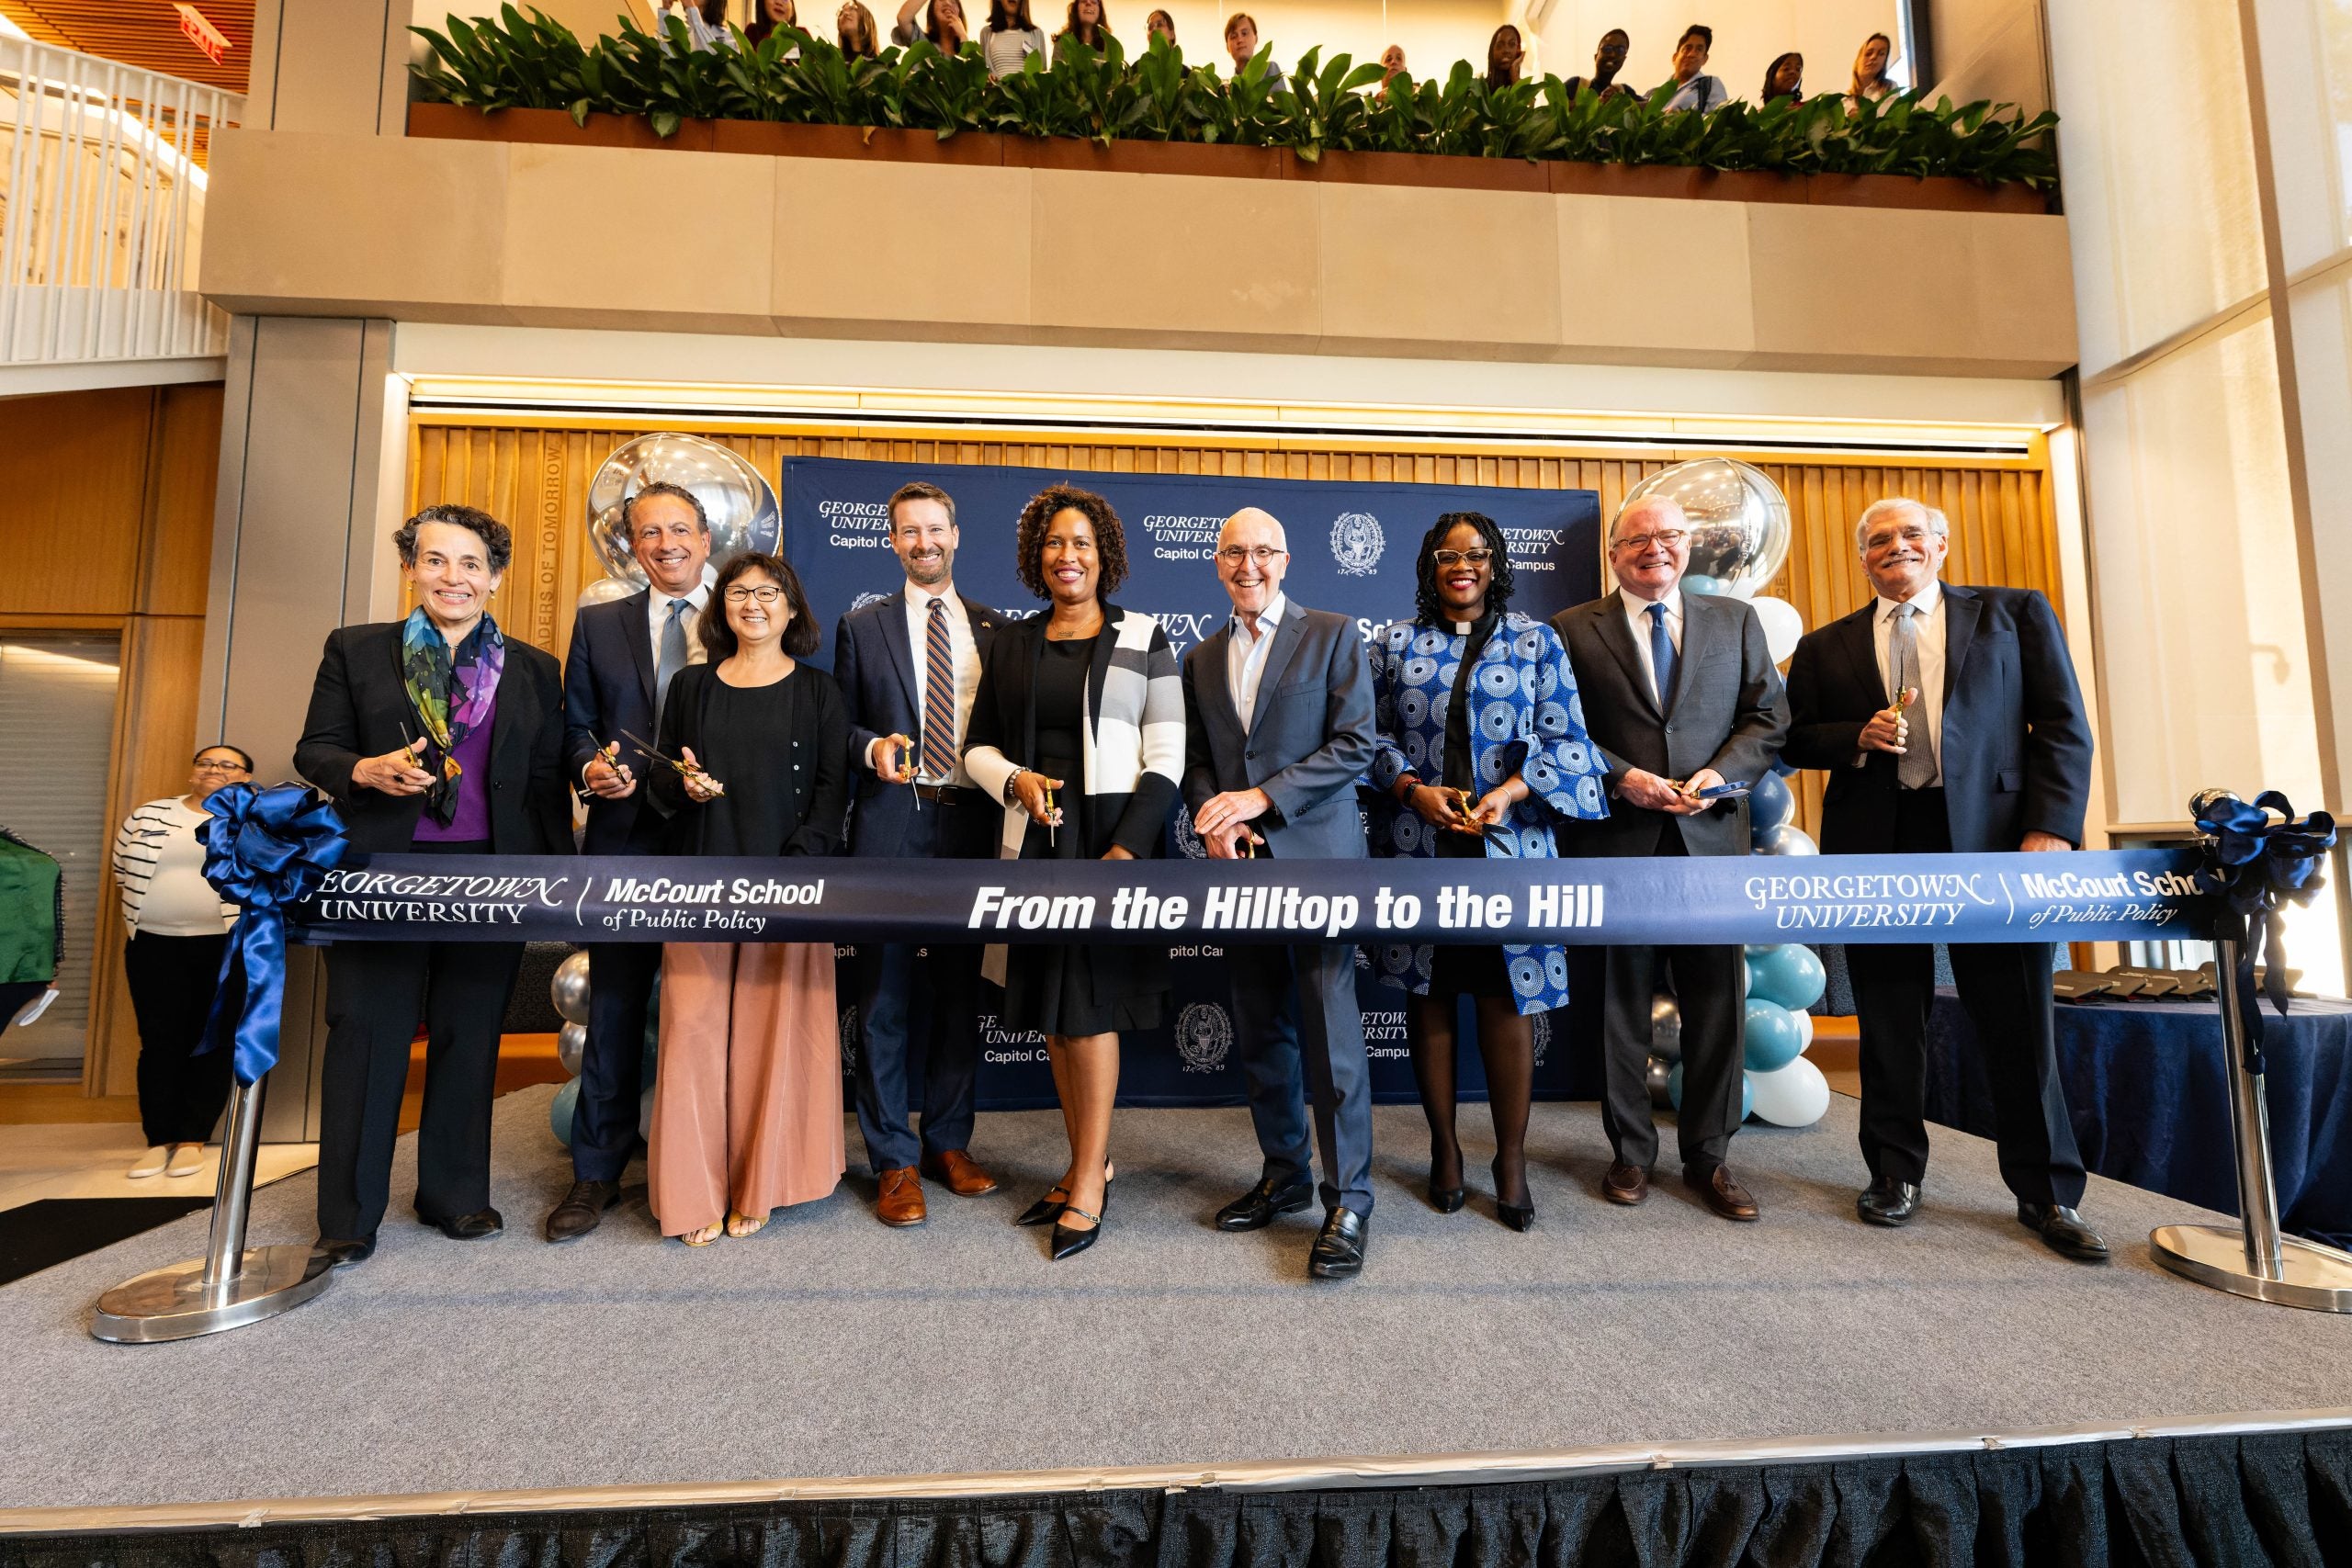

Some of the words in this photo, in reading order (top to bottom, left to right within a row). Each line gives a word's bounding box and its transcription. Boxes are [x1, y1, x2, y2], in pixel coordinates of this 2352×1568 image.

[819, 501, 888, 518] GEORGE
[831, 515, 891, 531] UNIVER
[1143, 514, 1228, 532] GEORGETO
[830, 535, 877, 549] Capitol
[1155, 529, 1220, 543] UNIVERS
[1498, 527, 1565, 546] ETOWN
[1154, 547, 1199, 561] Capitol
[1505, 541, 1551, 554] RSITY
[540, 561, 555, 584] OF
[1505, 558, 1555, 572] Campus
[537, 592, 553, 650] ADERS
[299, 869, 569, 907] EORGETOWN
[604, 877, 724, 904] McCourt
[729, 878, 825, 905] School
[1745, 873, 1996, 910] GEORGETOWN
[2020, 871, 2136, 899] McCourt
[319, 899, 527, 924] UNIVERSITY
[967, 886, 1096, 930] From
[1111, 886, 1189, 930] the
[1201, 886, 1359, 938] Hilltop
[1374, 886, 1421, 930] to
[1437, 886, 1512, 929] the
[1527, 885, 1604, 928] Hill
[1776, 903, 1965, 930] UNIVERSITY
[2029, 905, 2058, 930] of
[2052, 903, 2117, 923] Public
[2116, 903, 2178, 927] Policy
[603, 908, 627, 931] of
[629, 908, 696, 929] Public
[703, 908, 766, 934] Policy
[1169, 944, 1198, 959] pitol
[986, 1030, 1046, 1043] UNIVER
[1363, 1026, 1408, 1040] RSITY
[984, 1049, 1032, 1064] Capitol
[1365, 1045, 1409, 1060] Campu
